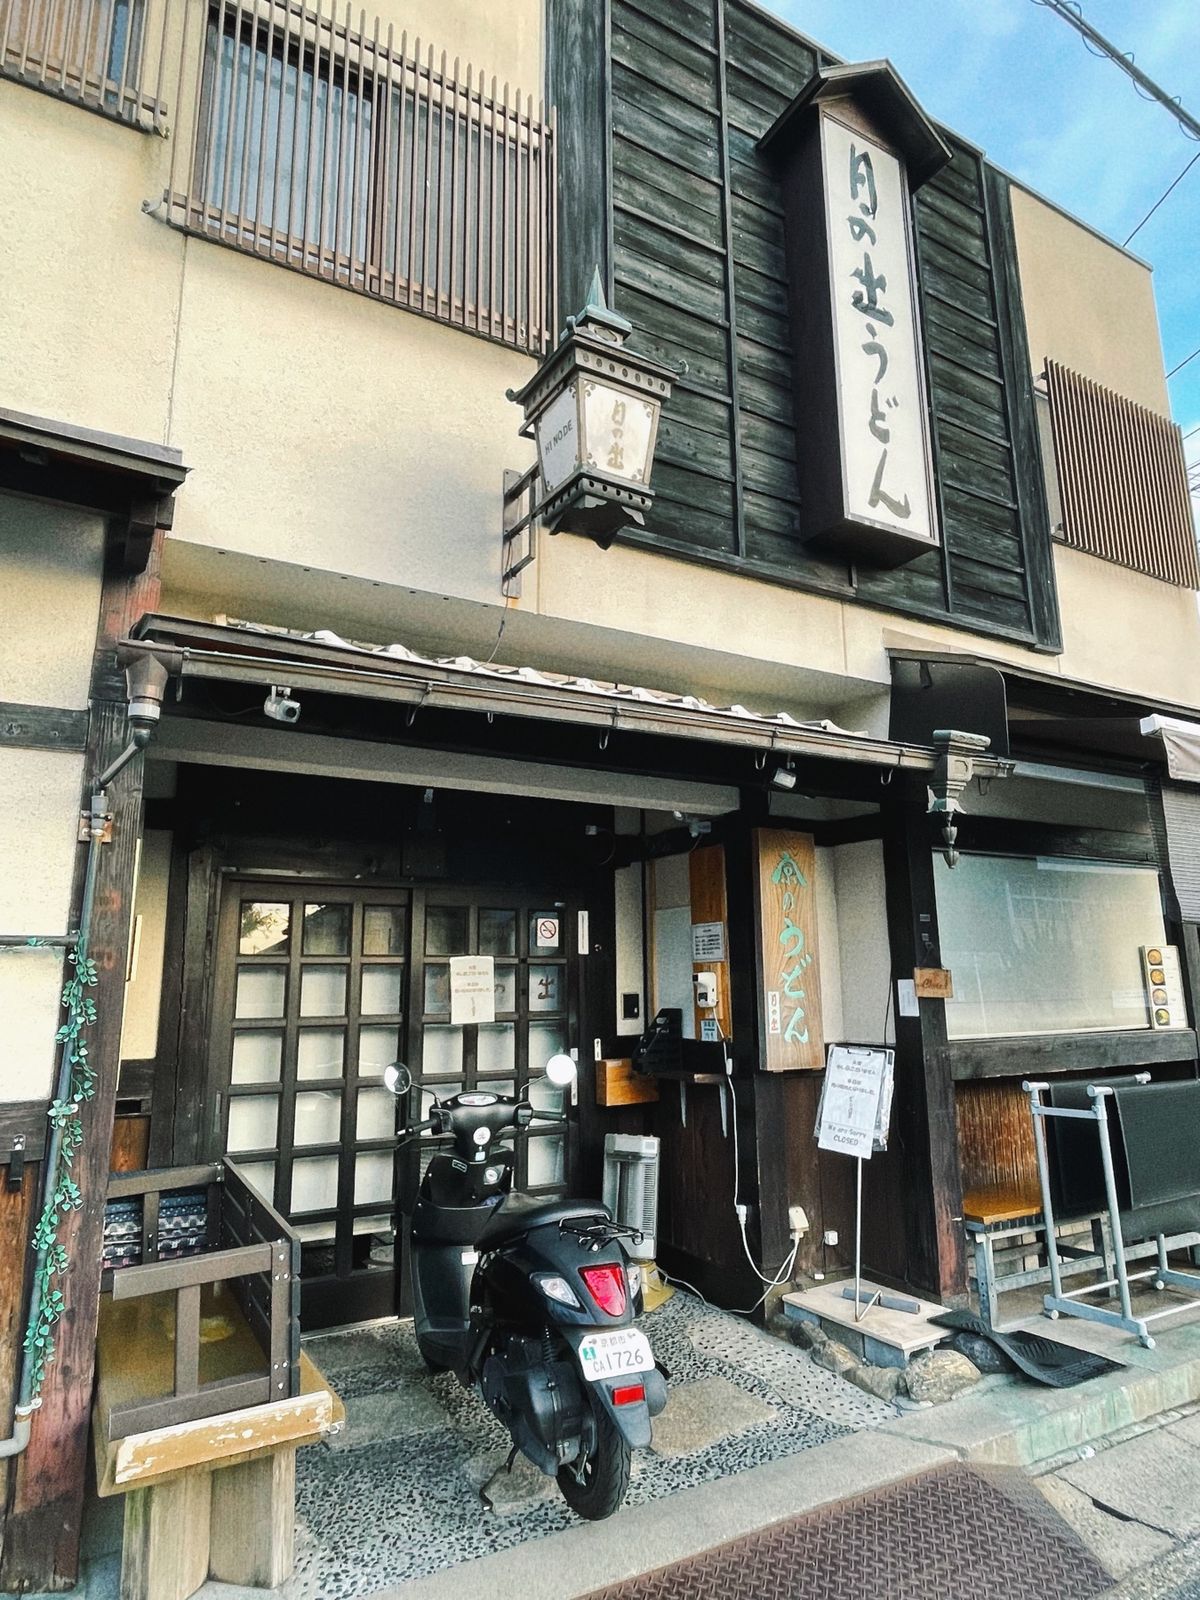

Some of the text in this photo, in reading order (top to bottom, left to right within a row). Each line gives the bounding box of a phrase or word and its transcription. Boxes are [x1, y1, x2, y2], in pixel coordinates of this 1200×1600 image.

[847, 142, 912, 519] 日の出うどん
[607, 399, 626, 471] 日の出
[833, 1134, 859, 1146] CLOSED
[606, 1348, 644, 1371] 1726
